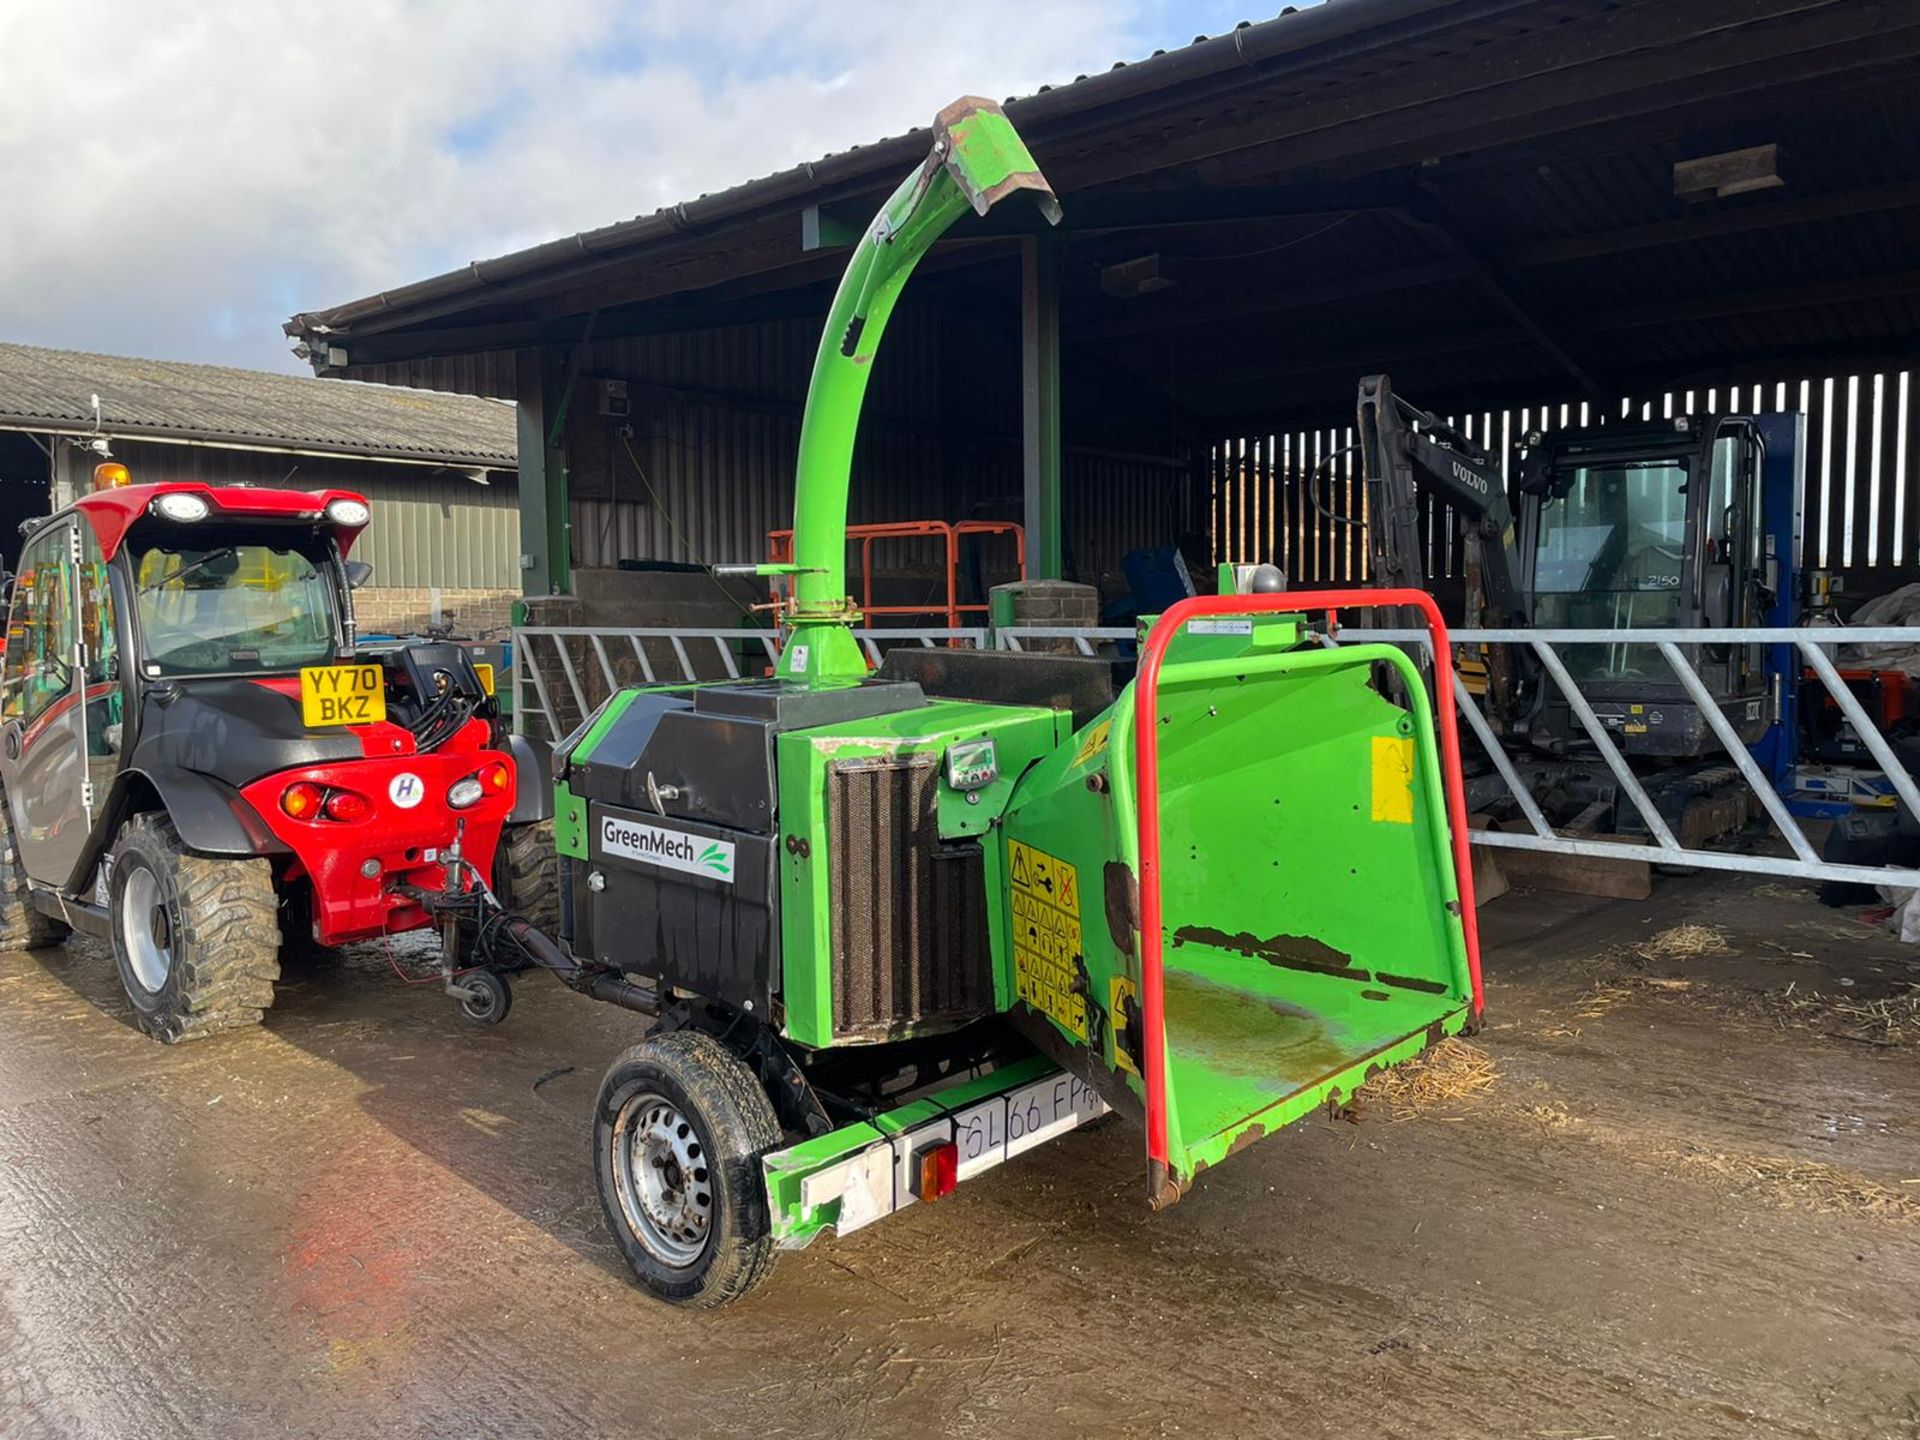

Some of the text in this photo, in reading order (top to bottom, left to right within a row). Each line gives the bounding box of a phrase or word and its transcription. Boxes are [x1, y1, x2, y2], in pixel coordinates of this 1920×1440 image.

[1452, 460, 1488, 494] VOLVO
[309, 668, 377, 694] YY70
[320, 695, 371, 721] BKZ
[603, 820, 695, 862] GreenMech
